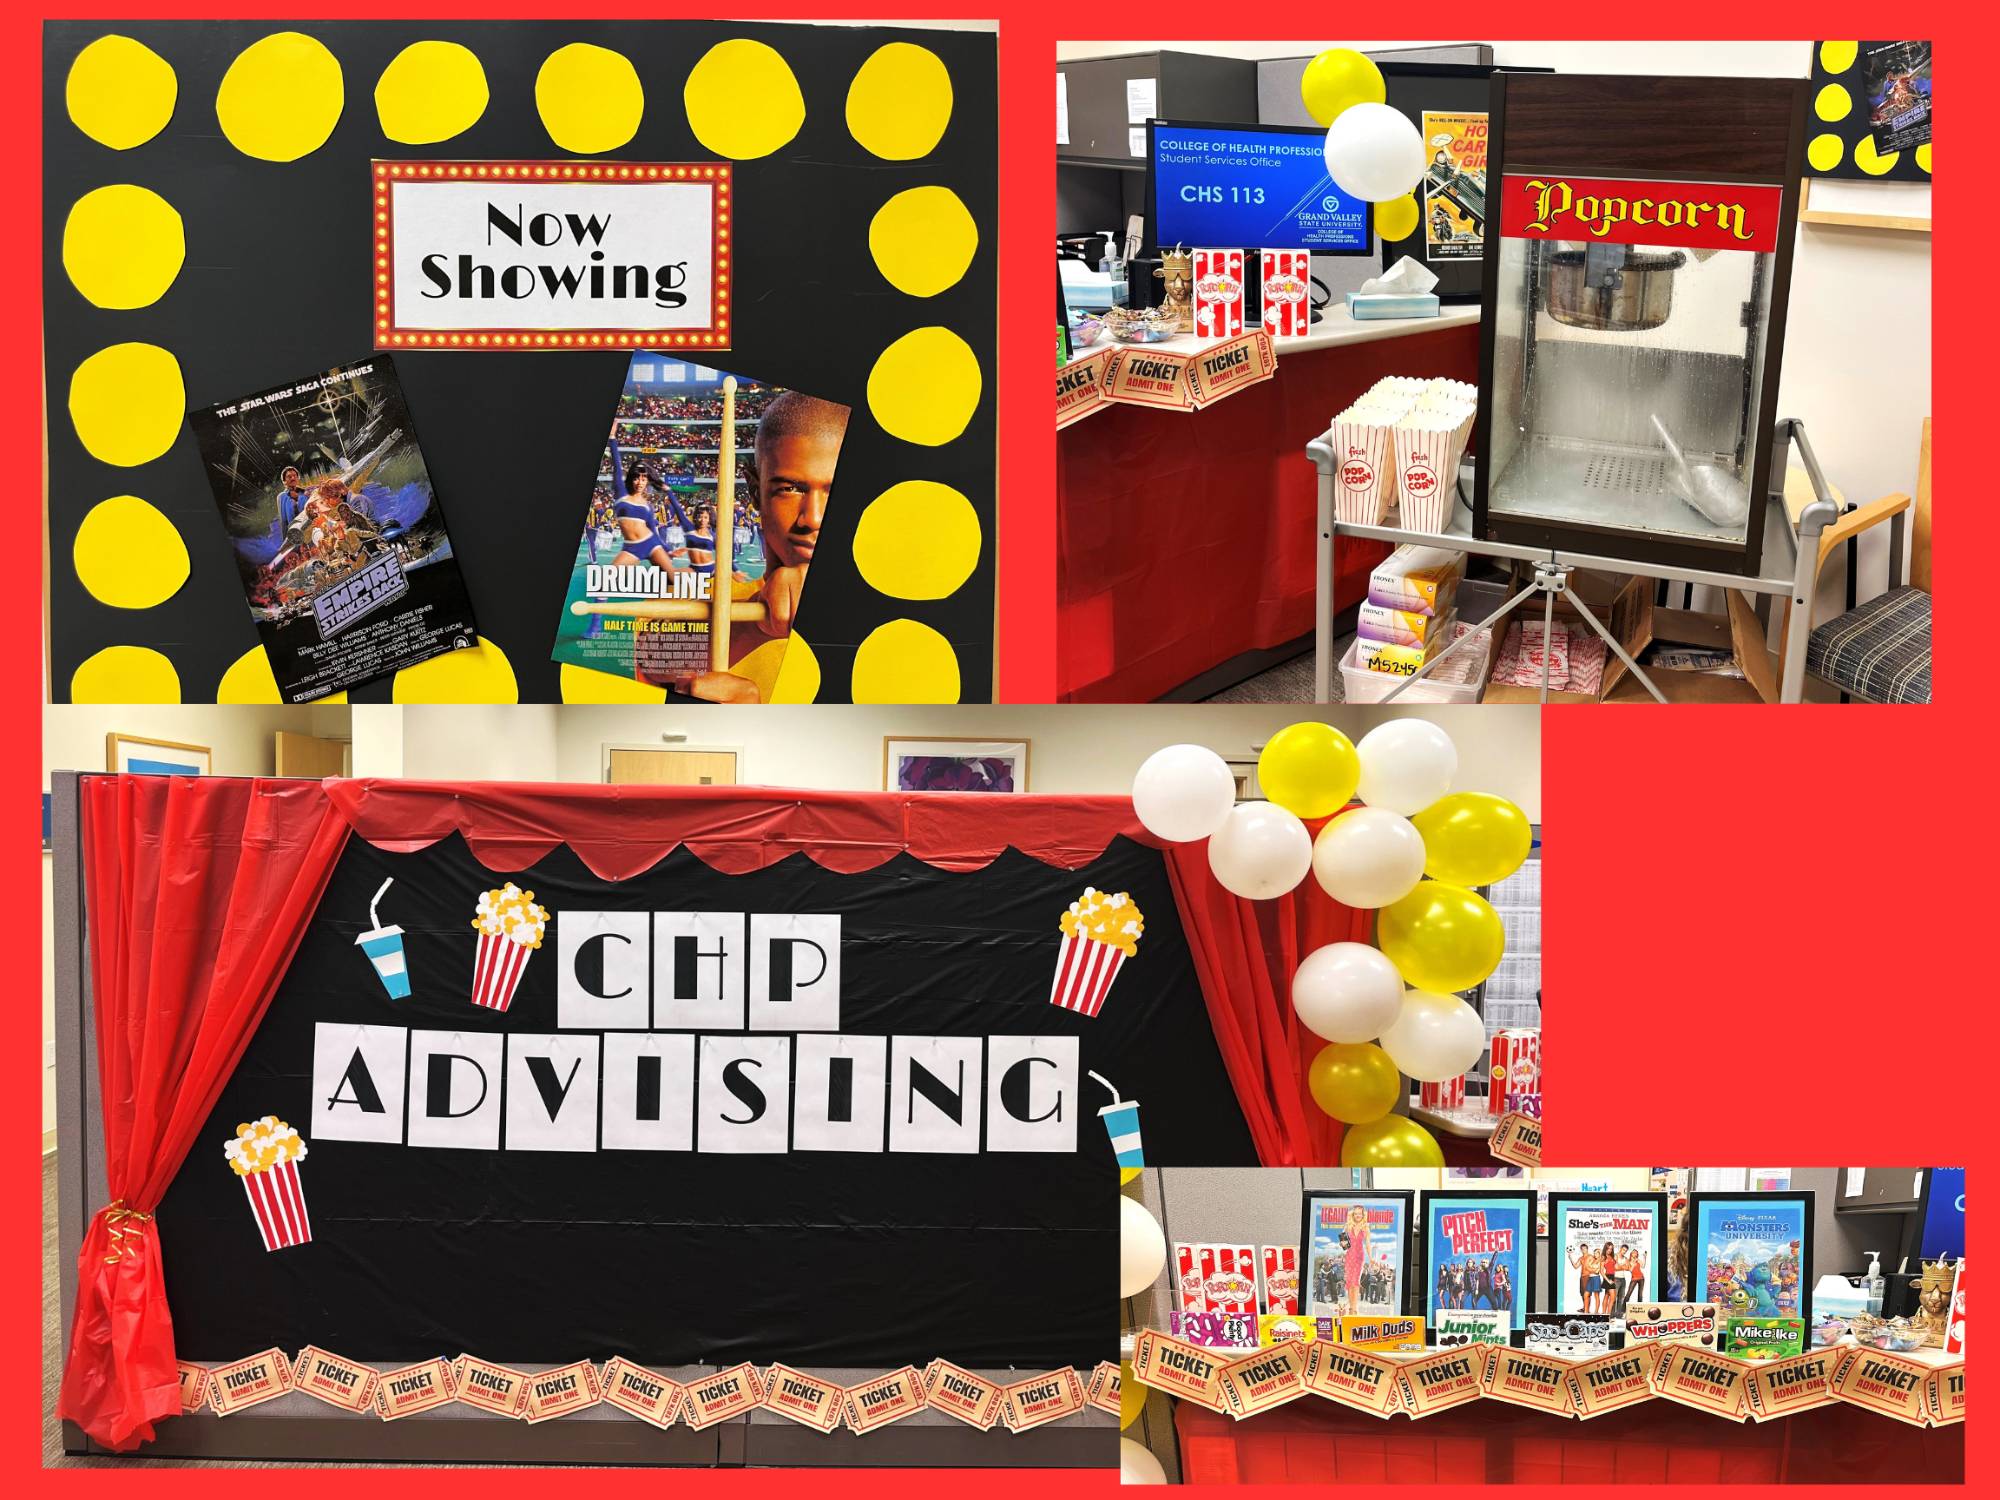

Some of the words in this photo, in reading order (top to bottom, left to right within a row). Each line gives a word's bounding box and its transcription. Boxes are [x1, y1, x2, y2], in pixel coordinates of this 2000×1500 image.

[1464, 125, 1488, 138] HO
[1159, 140, 1209, 152] COLLEGE
[1211, 142, 1227, 153] OF
[1229, 143, 1266, 155] HEALTH
[1269, 145, 1324, 157] PROFESSIO
[1453, 139, 1486, 153] CAR
[1159, 153, 1202, 164] Student
[1204, 155, 1248, 166] Services
[1249, 156, 1281, 168] Office
[1180, 185, 1223, 203] CHS
[1231, 187, 1265, 204] 113
[1298, 212, 1330, 221] GRAND
[1331, 213, 1362, 222] VALLEY
[1523, 179, 1754, 240] Popcorn
[487, 201, 612, 247] Now
[420, 250, 688, 308] Showing
[1128, 358, 1181, 381] TICKET
[1203, 345, 1249, 376] TICKET
[1056, 365, 1094, 396] CKET
[1126, 376, 1156, 390] ADMIT
[1157, 381, 1174, 392] ONE
[1209, 371, 1234, 387] ADMIT
[1235, 362, 1251, 376] ONE
[216, 405, 237, 419] THE
[239, 399, 265, 412] STAR
[264, 388, 294, 404] WARS
[295, 381, 320, 394] SAGA
[320, 364, 374, 387] CONTINUES
[1056, 393, 1075, 410] MIT
[1078, 384, 1097, 401] ONE
[1344, 467, 1365, 476] POP
[1345, 471, 1372, 485] CORN
[1407, 472, 1428, 482] POP
[1408, 477, 1435, 490] CORN
[314, 556, 401, 621] EMPIRE
[320, 592, 372, 631] STRIKES
[371, 573, 404, 600] BACK
[603, 620, 626, 631] HALF
[627, 621, 649, 632] TIME
[650, 622, 660, 632] IS
[661, 622, 686, 632] GAME
[687, 622, 709, 633] TIME
[573, 933, 828, 1002] CHP
[327, 1046, 1062, 1127] ADVISING
[1512, 1141, 1537, 1157] ADMIT
[1442, 1210, 1487, 1237] PITCH
[1568, 1218, 1599, 1229] She's
[1613, 1218, 1650, 1230] MAN
[1720, 1220, 1790, 1232] MONSTERS
[1725, 1232, 1785, 1240] UNIVERSITY
[1452, 1229, 1513, 1256] PERFECT
[1269, 1328, 1307, 1338] Raisinets
[1351, 1325, 1378, 1341] Milk
[1382, 1320, 1414, 1336] Duds
[1438, 1319, 1497, 1334] Junior
[1632, 1319, 1712, 1336] WHOPPERS
[1735, 1326, 1772, 1338] Mike
[1775, 1328, 1798, 1340] Ike
[315, 1360, 360, 1388] TICKET
[1159, 1346, 1213, 1379] TICKET
[1238, 1355, 1293, 1387] TICKET
[1329, 1353, 1384, 1385] TICKET
[1415, 1358, 1471, 1386] TICKET
[1507, 1358, 1562, 1386] TICKET
[1585, 1357, 1642, 1387] TICKET
[1680, 1357, 1739, 1388] TICKET
[1766, 1359, 1826, 1388] TICKET
[224, 1364, 268, 1390] TICKET
[230, 1384, 254, 1398] ADMIT
[255, 1378, 271, 1391] ONE
[389, 1372, 433, 1396] TICKET
[470, 1368, 513, 1393] TICKET
[535, 1374, 577, 1398] TICKET
[620, 1371, 665, 1400] TICKET
[942, 1374, 985, 1402] TICKET
[1158, 1365, 1187, 1383] ADMIT
[1189, 1376, 1208, 1390] ONE
[1327, 1371, 1356, 1389] ADMIT
[1357, 1382, 1377, 1396] ONE
[1504, 1376, 1535, 1393] ADMIT
[1537, 1384, 1556, 1396] ONE
[1677, 1376, 1707, 1392] ADMIT
[1708, 1386, 1728, 1398] ONE
[1860, 1359, 1921, 1392] TICKET
[697, 1377, 740, 1404] TICKET
[781, 1378, 825, 1404] TICKET
[859, 1381, 903, 1407] TICKET
[1016, 1381, 1061, 1405] TICKET
[866, 1402, 889, 1416] ADMIT
[890, 1396, 905, 1407] ONE
